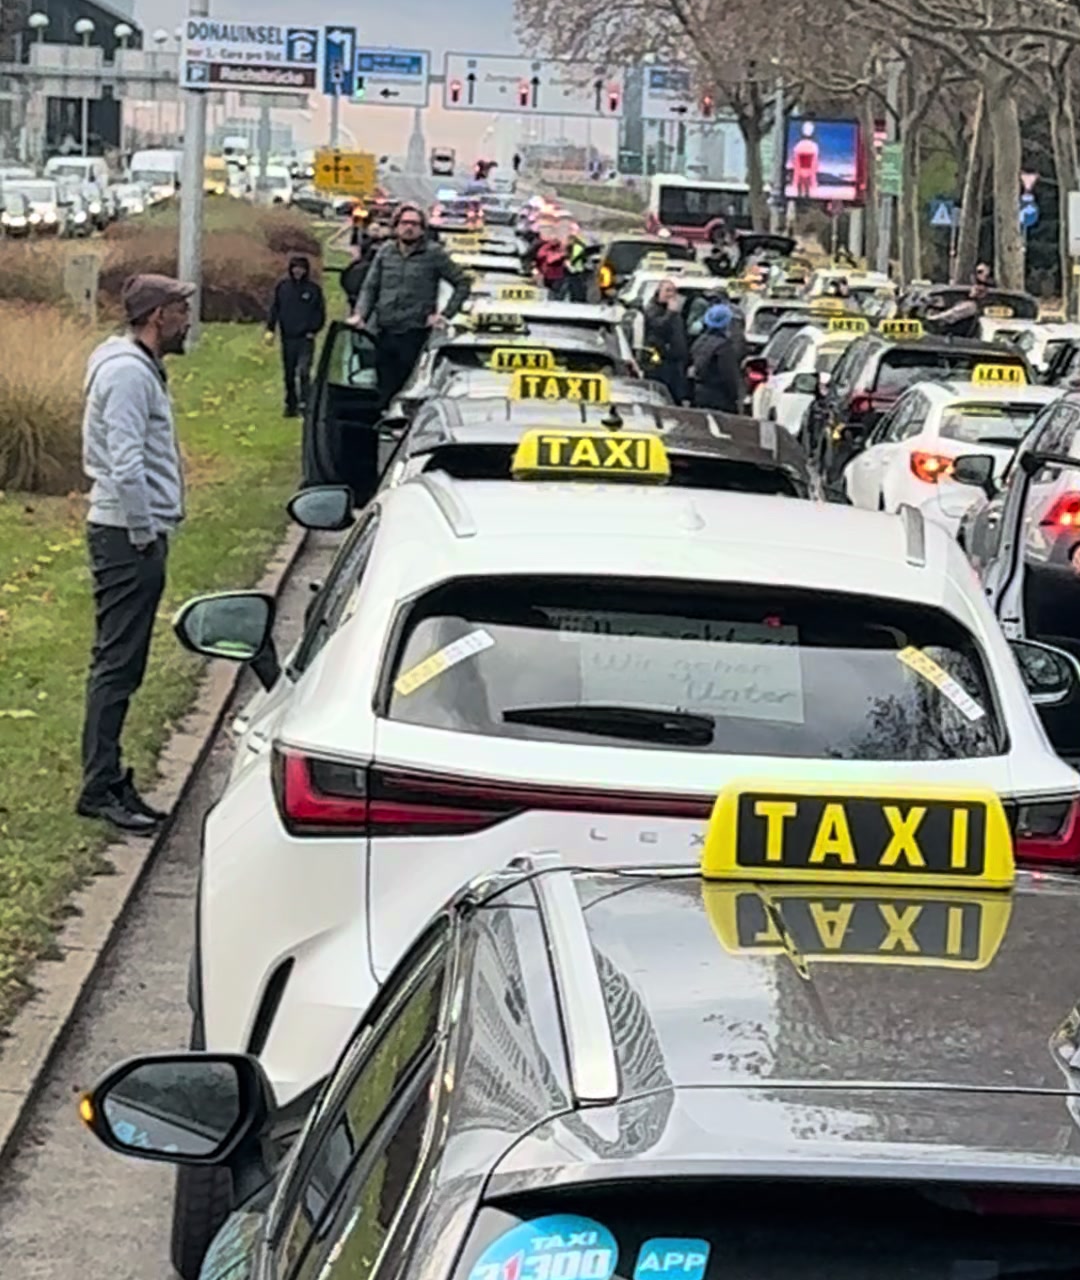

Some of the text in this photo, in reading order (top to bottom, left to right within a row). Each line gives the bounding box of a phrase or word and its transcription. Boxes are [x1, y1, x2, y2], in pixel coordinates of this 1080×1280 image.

[187, 21, 283, 45] DONAUINSEL
[503, 352, 548, 369] TAXI
[524, 376, 599, 401] TAXI
[540, 437, 649, 469] TAXI
[686, 678, 796, 703] Unter
[753, 800, 968, 869] TAXI
[529, 1231, 598, 1251] TAXI
[640, 1252, 707, 1272] APP
